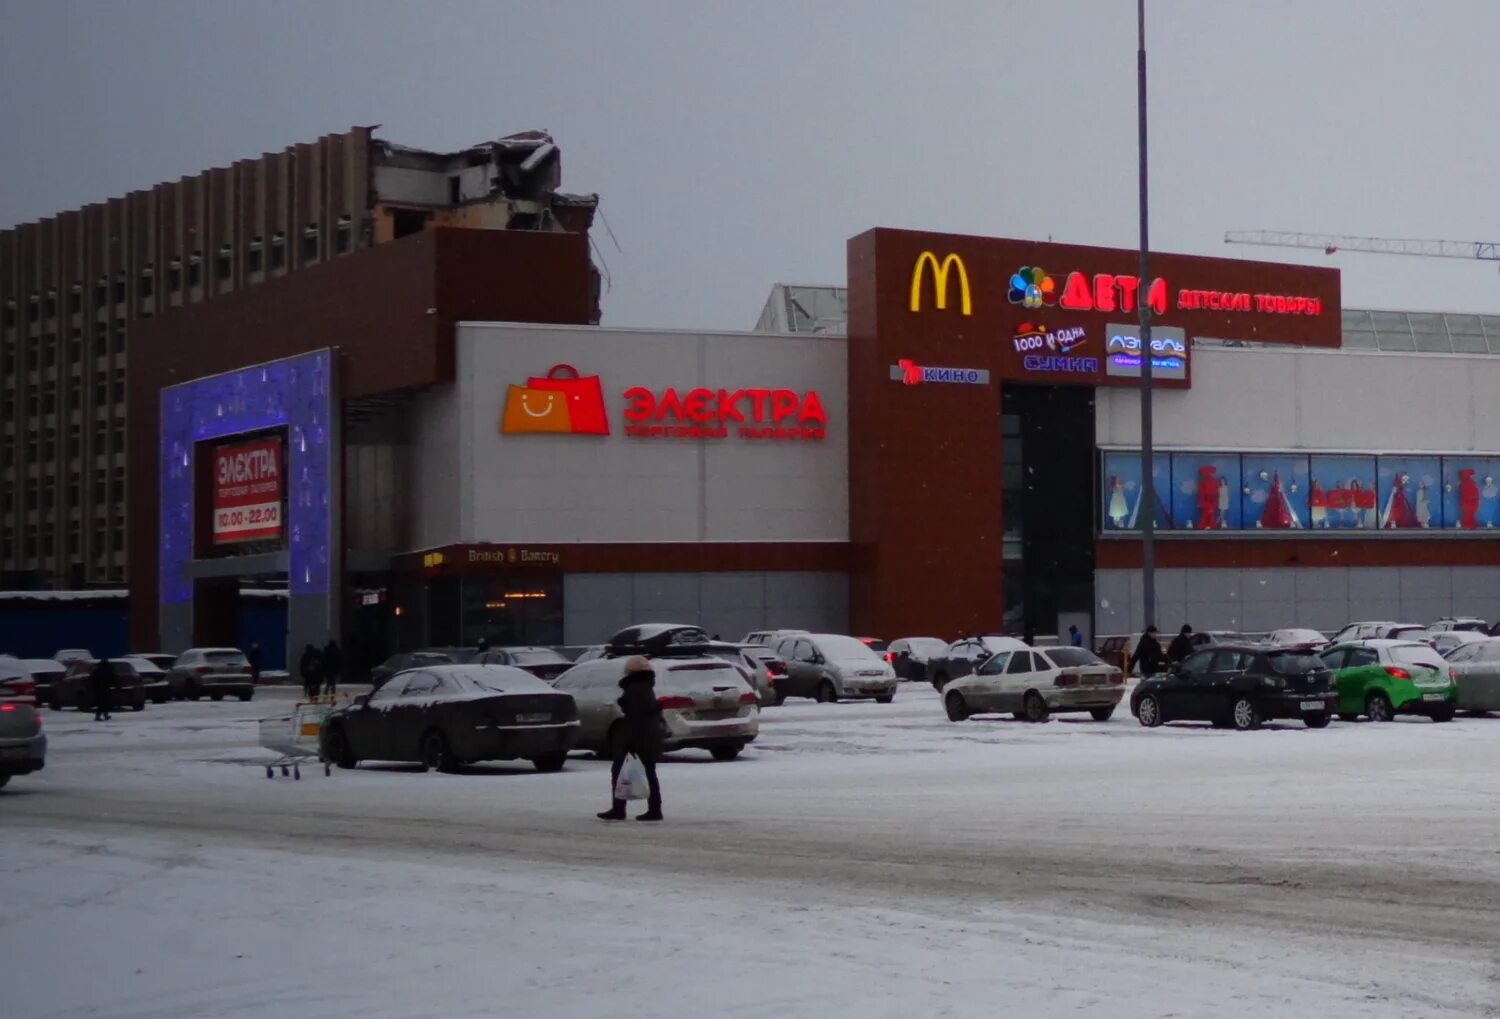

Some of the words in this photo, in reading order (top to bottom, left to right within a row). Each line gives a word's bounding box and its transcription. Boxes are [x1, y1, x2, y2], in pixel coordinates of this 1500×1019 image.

[1060, 272, 1168, 315] ДЕТИ
[1177, 289, 1250, 312] ДЕТСКИЕ
[1254, 294, 1321, 315] ТОВАРЫ
[1013, 335, 1043, 352] 1000
[1046, 332, 1055, 345] И
[1056, 327, 1086, 342] ОДНА
[924, 367, 979, 383] КИНО
[468, 550, 504, 562] British
[520, 550, 559, 564] Bakery
